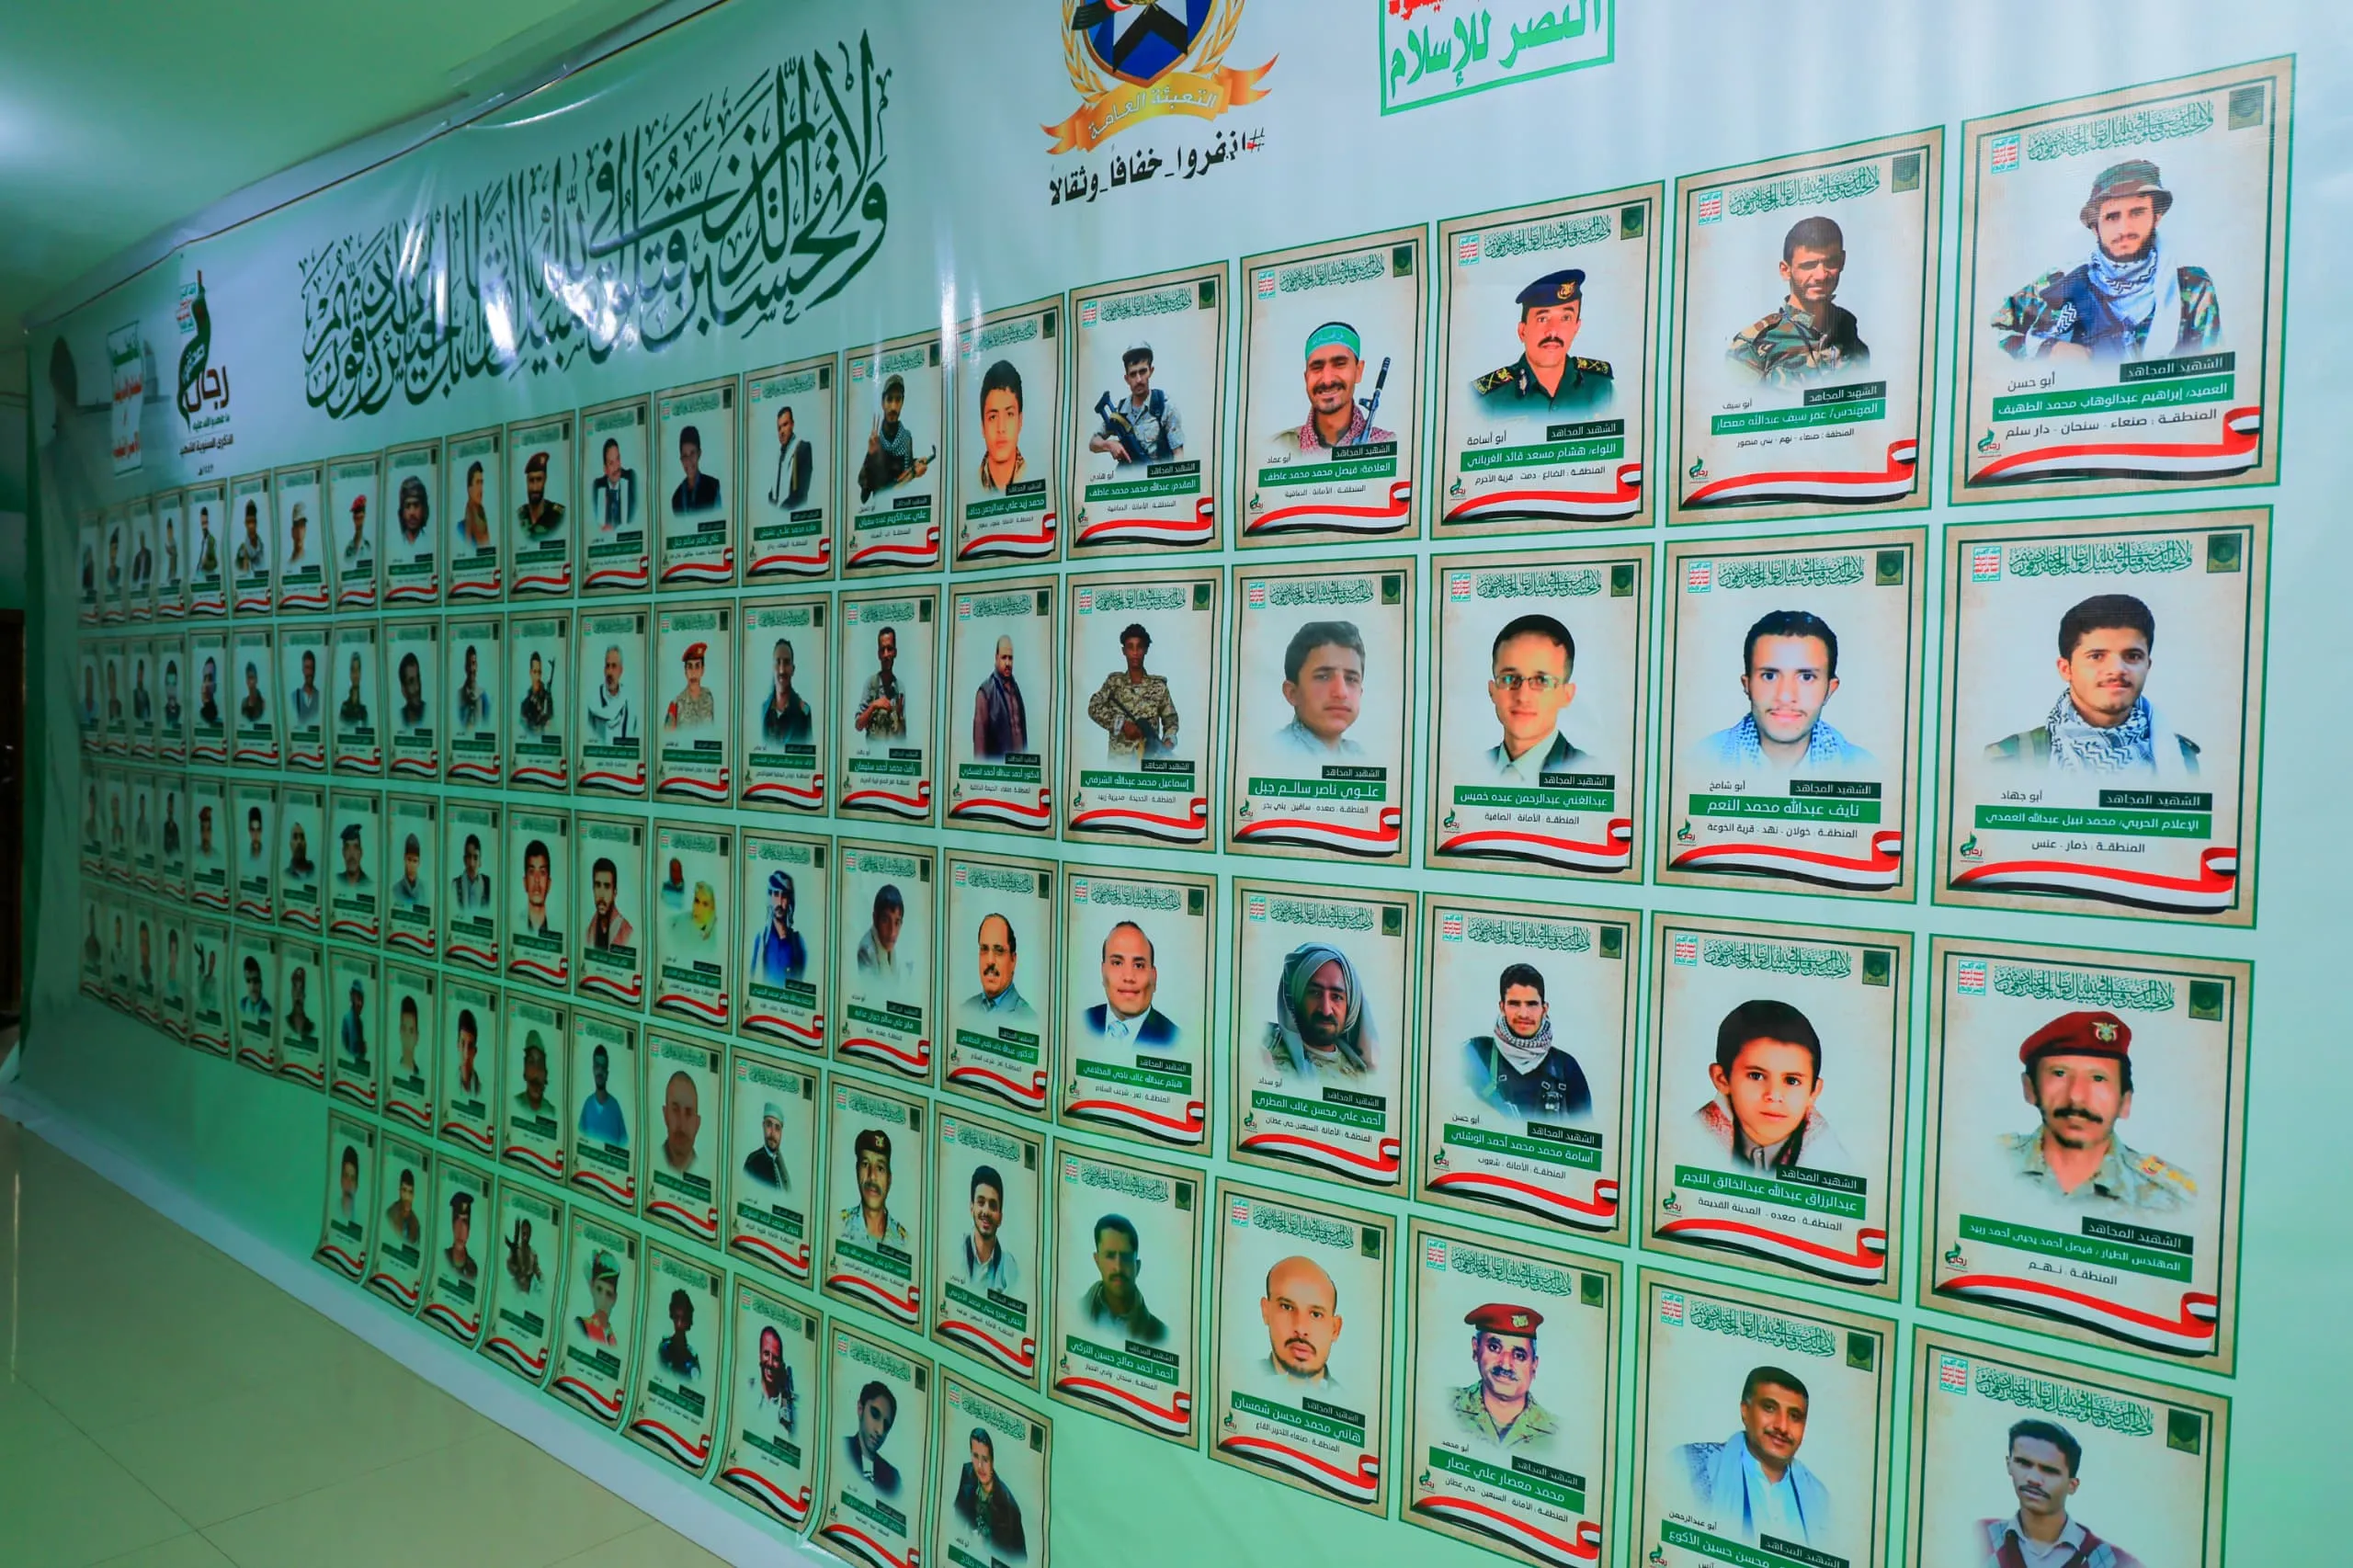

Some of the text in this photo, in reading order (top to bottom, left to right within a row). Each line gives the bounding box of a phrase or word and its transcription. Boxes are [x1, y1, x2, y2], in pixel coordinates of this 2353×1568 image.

[1391, 8, 1492, 100] للإسلام
[2128, 357, 2223, 378] الشهيد المجاهد
[2007, 371, 2056, 392] أبو حسن
[1809, 386, 1877, 403] الشهيد المجاهد
[2080, 393, 2138, 408] عبدالوهاب
[1722, 399, 1753, 410] أبو سيف
[2045, 400, 2076, 410] محمد
[1467, 430, 1506, 447] أبو أسامة
[1709, 781, 1745, 791] أبو شامخ
[1795, 783, 1871, 795] الشهيد المجاهد
[2001, 790, 2043, 802] أبو جهاد
[2107, 794, 2200, 807] الشهيد المجاهد
[1744, 803, 1779, 813] محمد
[1783, 800, 1824, 815] عبدالله
[1829, 803, 1859, 818] نايف
[1781, 1167, 1857, 1190] الشهيد المجاهد
[1682, 1173, 1857, 1211] عبدالرزاق عبدالله عبدالخالق النجم
[2088, 1224, 2181, 1249] الشهيد المجاهد
